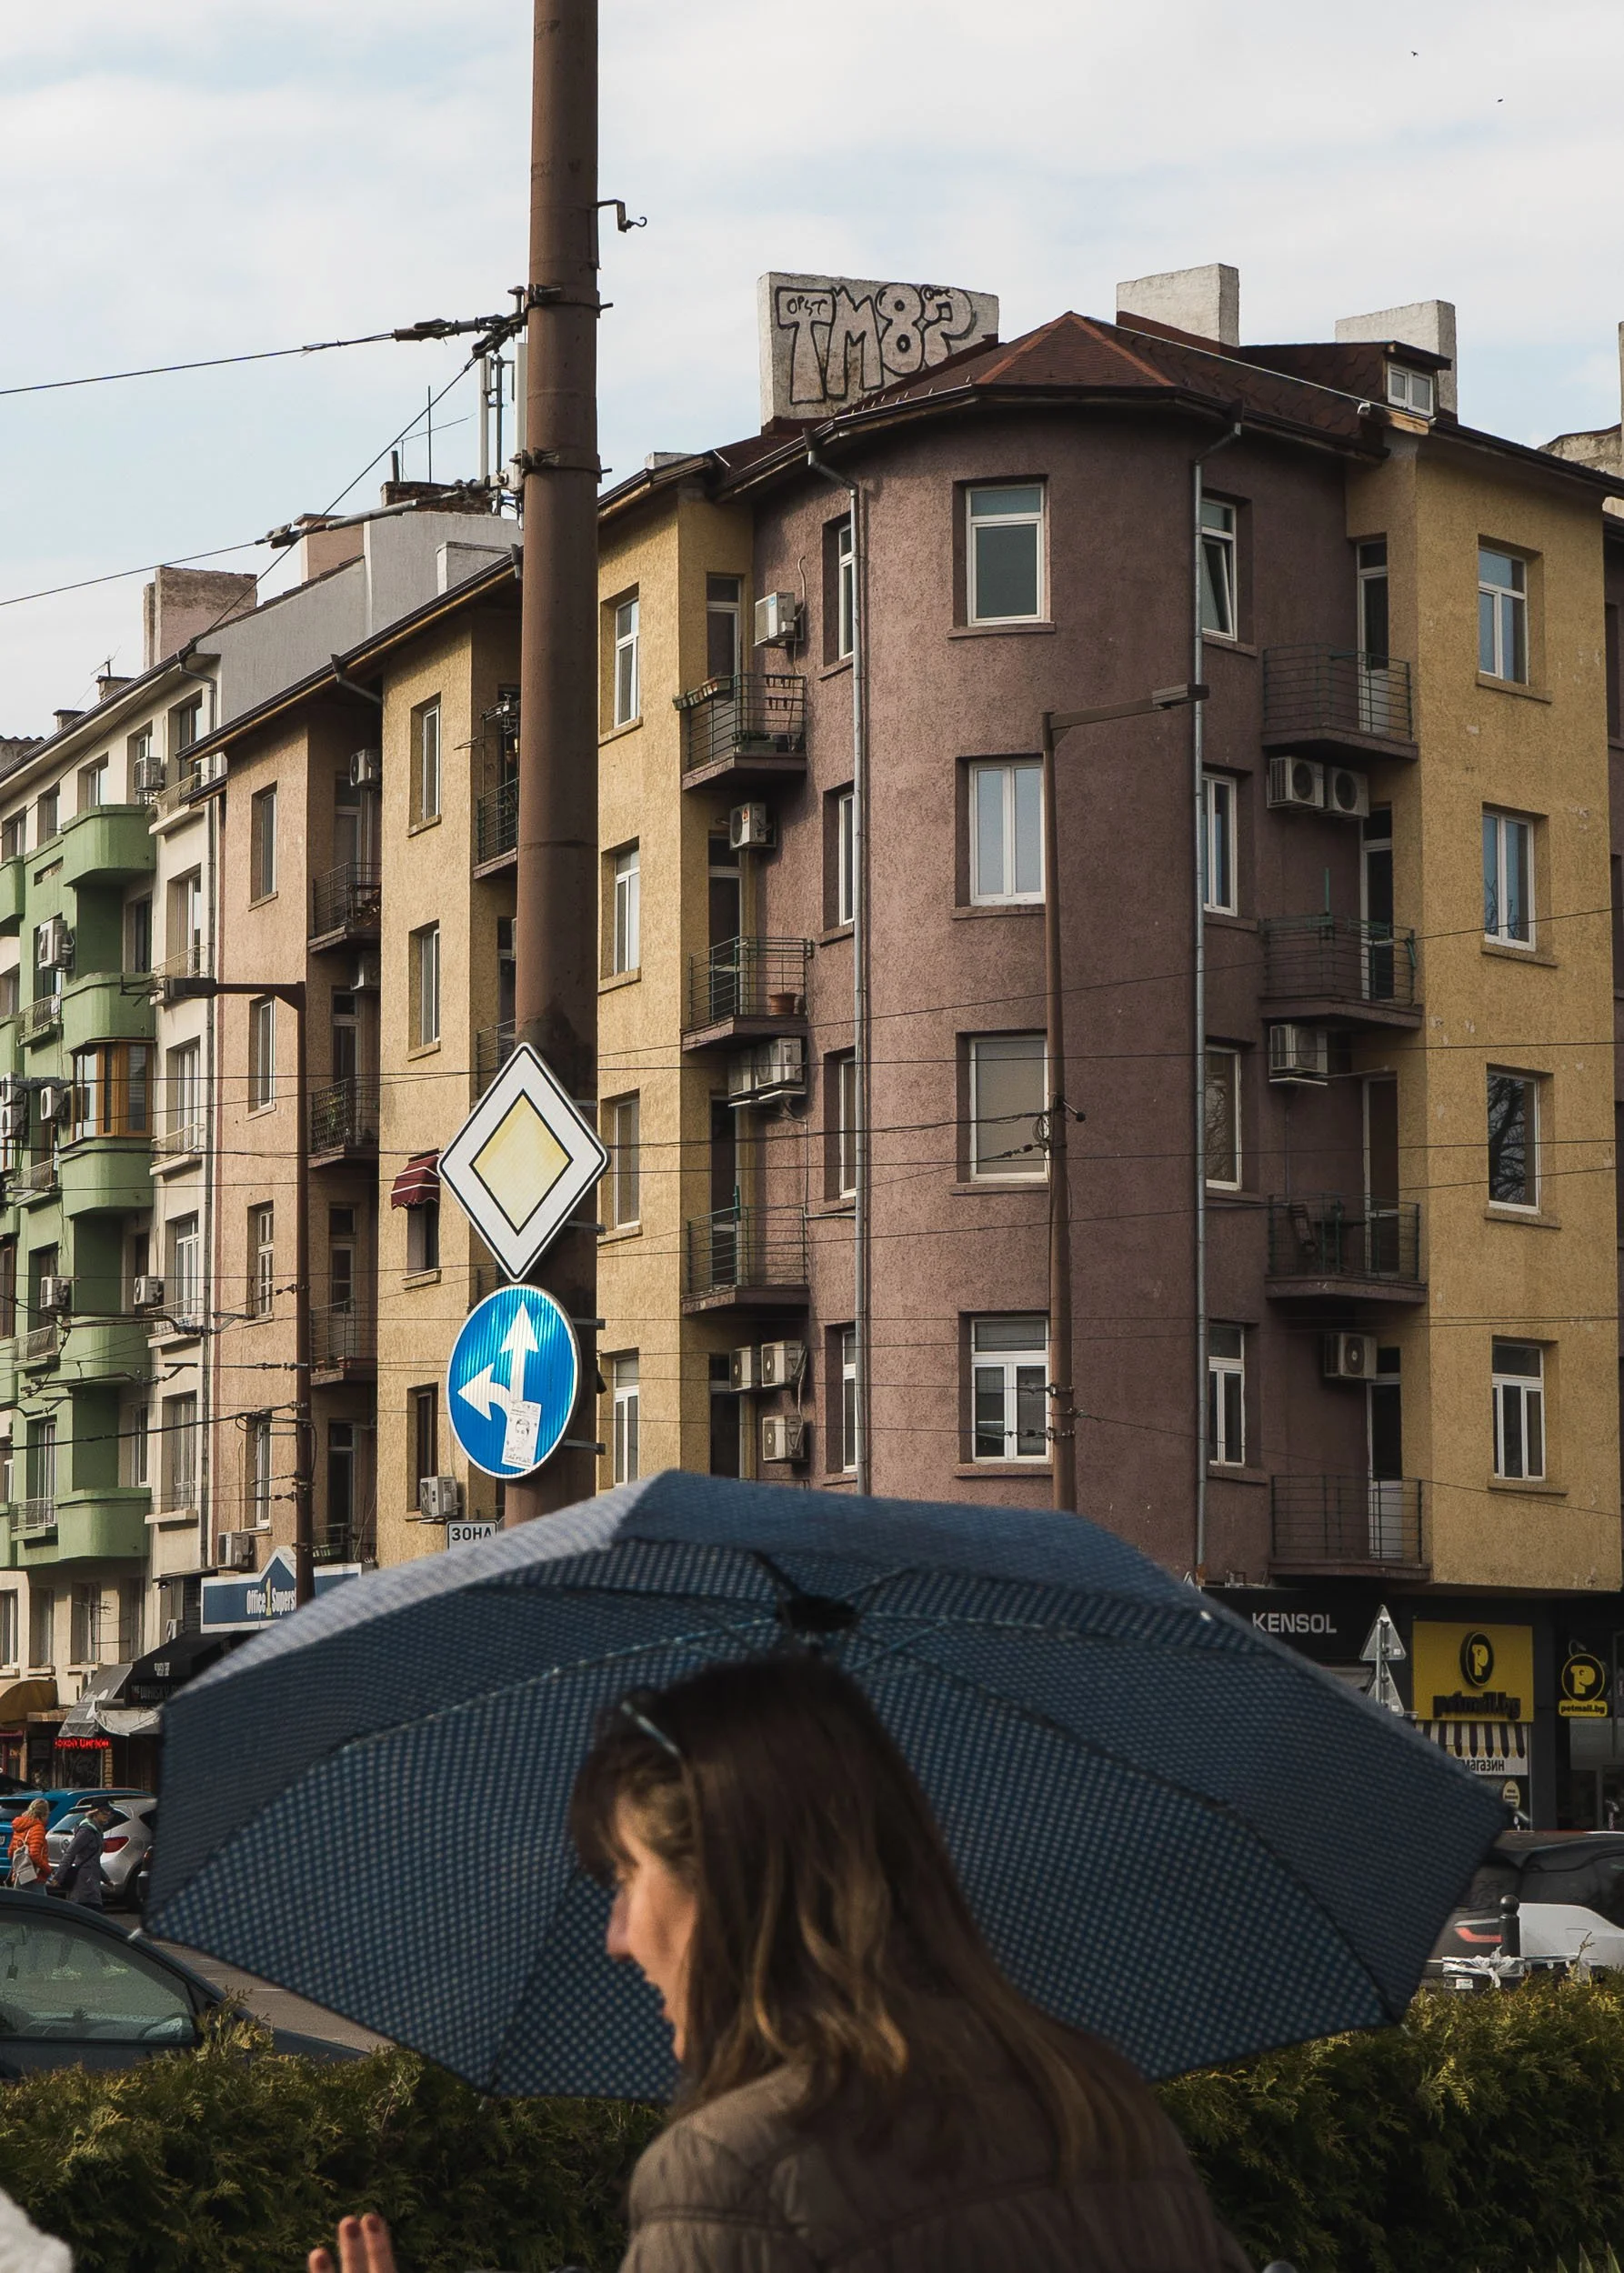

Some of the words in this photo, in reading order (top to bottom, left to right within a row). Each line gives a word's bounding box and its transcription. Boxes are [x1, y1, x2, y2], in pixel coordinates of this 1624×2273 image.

[452, 1527, 492, 1541] ЗОНА
[246, 1589, 266, 1615] Office
[266, 1577, 272, 1617] 1
[1252, 1613, 1338, 1634] KENSOL
